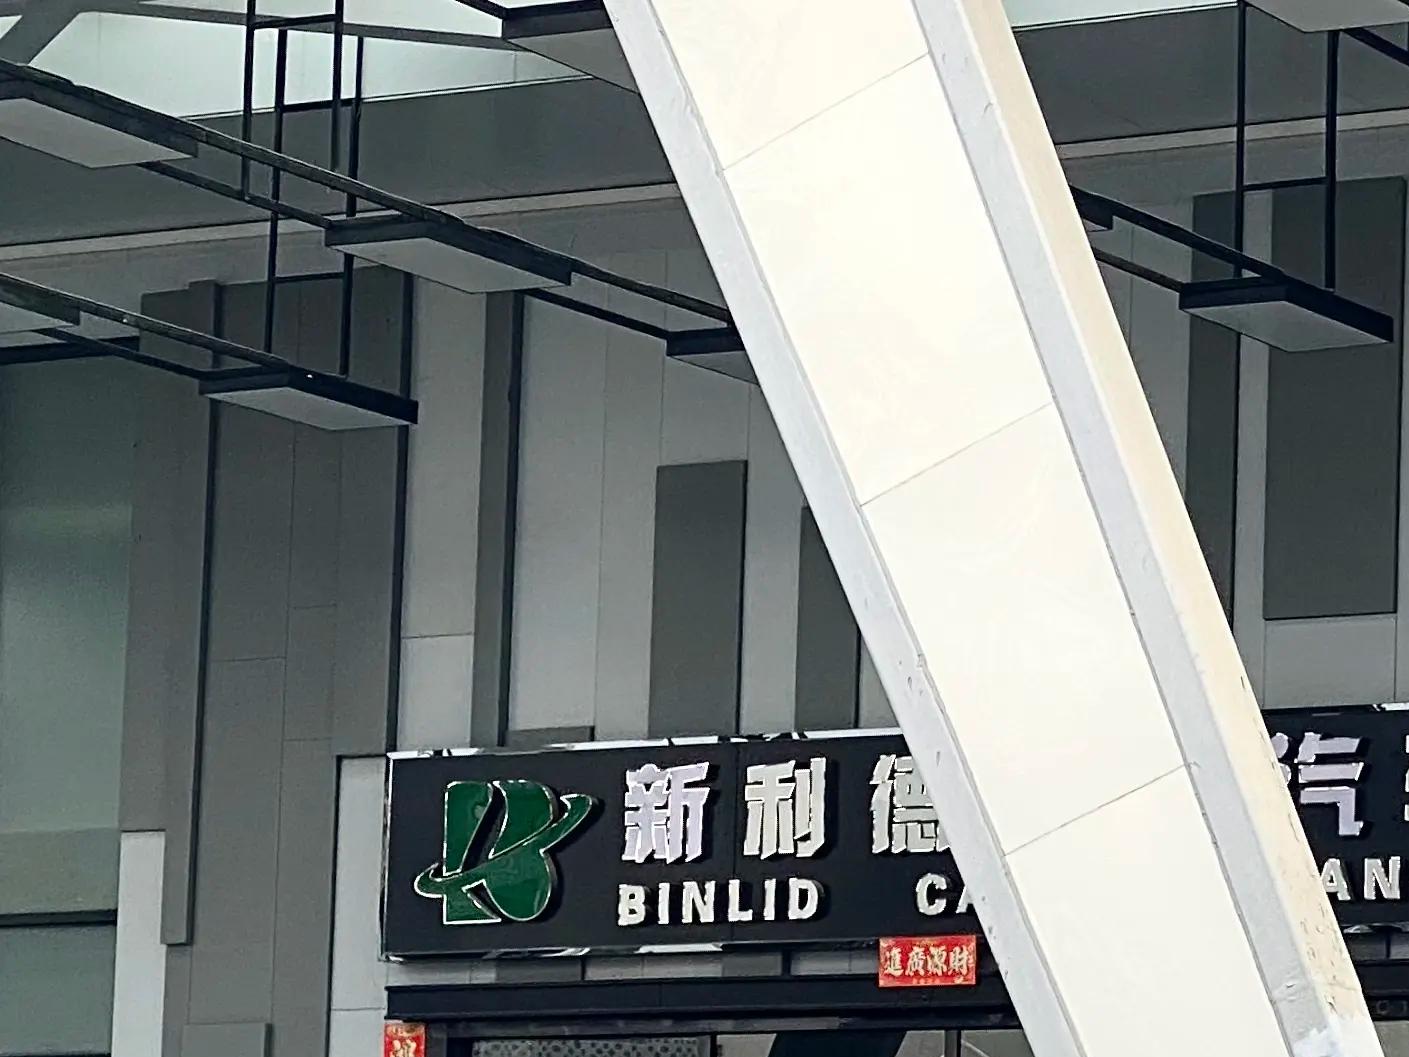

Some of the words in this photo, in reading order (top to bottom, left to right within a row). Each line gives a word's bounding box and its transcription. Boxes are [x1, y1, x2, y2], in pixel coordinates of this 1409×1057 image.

[621, 754, 951, 865] 新利德
[617, 877, 818, 926] BINLID
